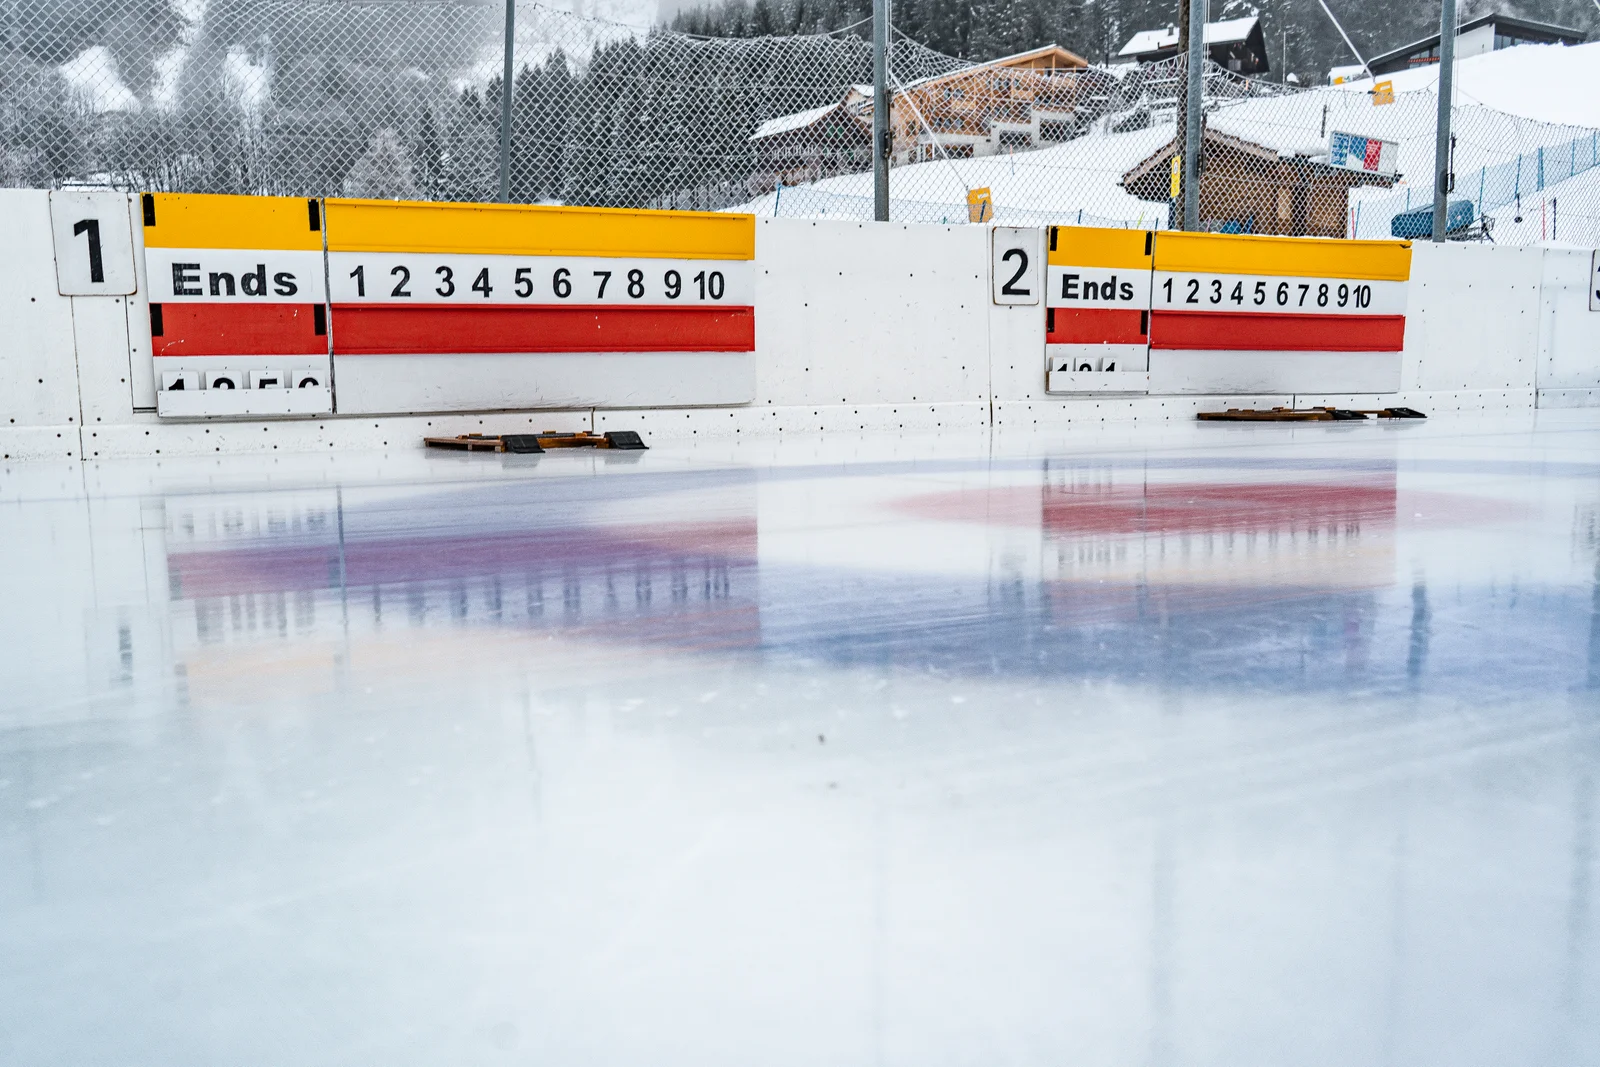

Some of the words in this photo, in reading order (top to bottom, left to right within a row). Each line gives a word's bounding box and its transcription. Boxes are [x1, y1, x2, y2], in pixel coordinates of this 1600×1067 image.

[73, 218, 105, 284] 1
[171, 262, 298, 297] Ends
[349, 265, 366, 297] 1
[390, 265, 412, 298] 2
[435, 265, 455, 298] 3
[471, 267, 494, 298] 4
[514, 267, 534, 298] 5
[552, 267, 572, 299] 6
[593, 270, 612, 299] 7
[627, 268, 645, 299] 8
[663, 269, 682, 300] 9
[693, 270, 725, 300] 10
[1001, 248, 1031, 296] 2
[1061, 273, 1134, 301] Ends
[1162, 277, 1173, 303] 1
[1185, 278, 1200, 304] 2
[1209, 279, 1222, 305] 3
[1230, 280, 1244, 305] 4
[1253, 281, 1267, 306] 5
[1276, 281, 1289, 306] 6
[1297, 283, 1310, 307] 7
[1316, 283, 1329, 308] 8
[1337, 283, 1349, 308] 9
[1352, 284, 1371, 309] 10
